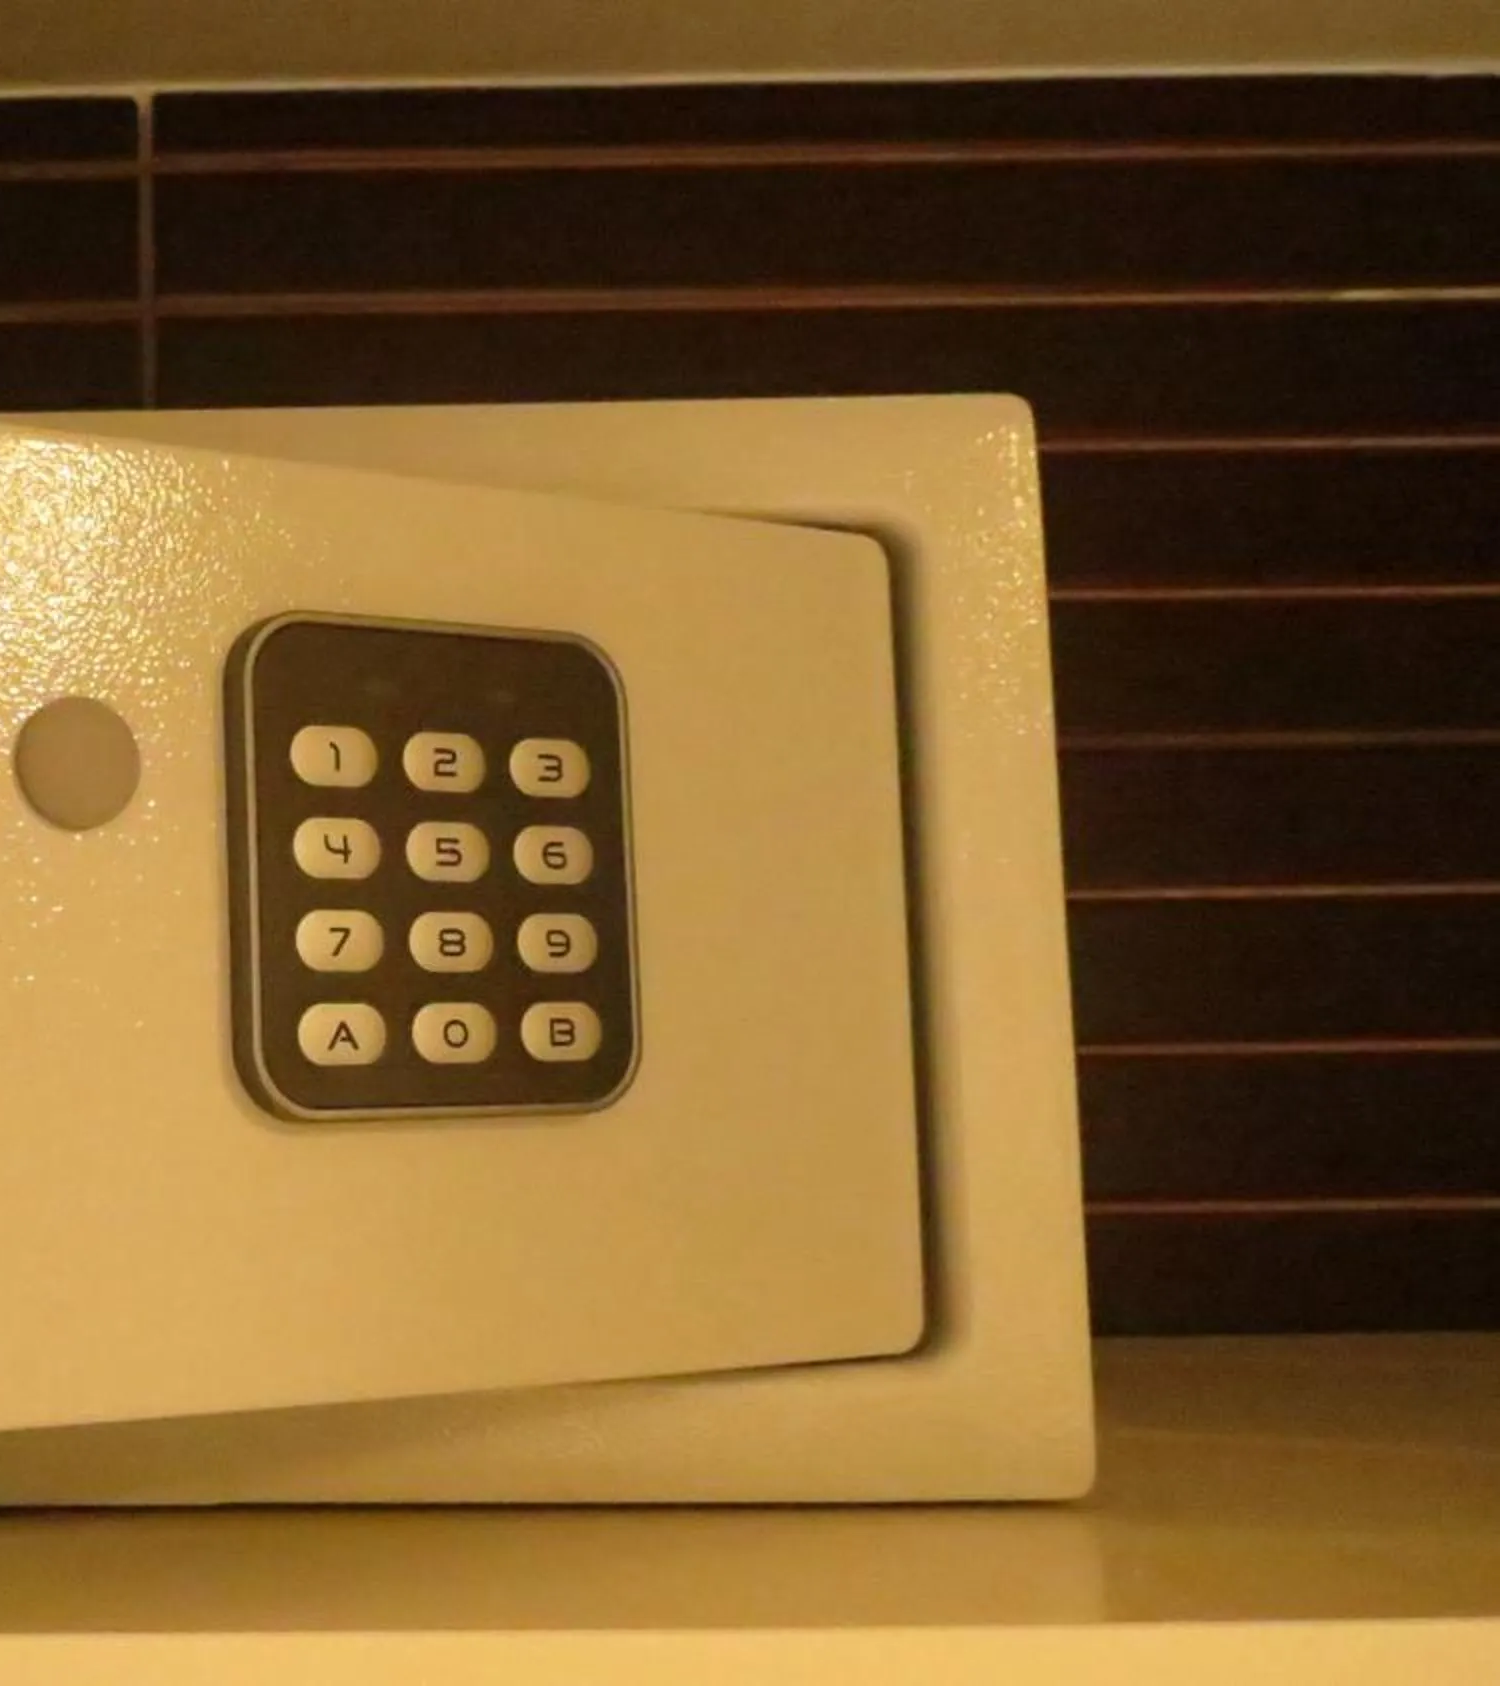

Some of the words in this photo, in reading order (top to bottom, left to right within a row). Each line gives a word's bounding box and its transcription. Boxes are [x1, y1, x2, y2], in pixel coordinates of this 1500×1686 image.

[328, 741, 342, 772] 1
[433, 747, 459, 778] 2
[537, 753, 564, 783] 3
[323, 833, 353, 864] 4
[435, 837, 463, 867] 5
[541, 841, 569, 871] 6
[328, 927, 351, 957] 7
[438, 928, 467, 958] 8
[546, 929, 572, 958] 9
[327, 1020, 360, 1051] A
[549, 1017, 576, 1047] B
